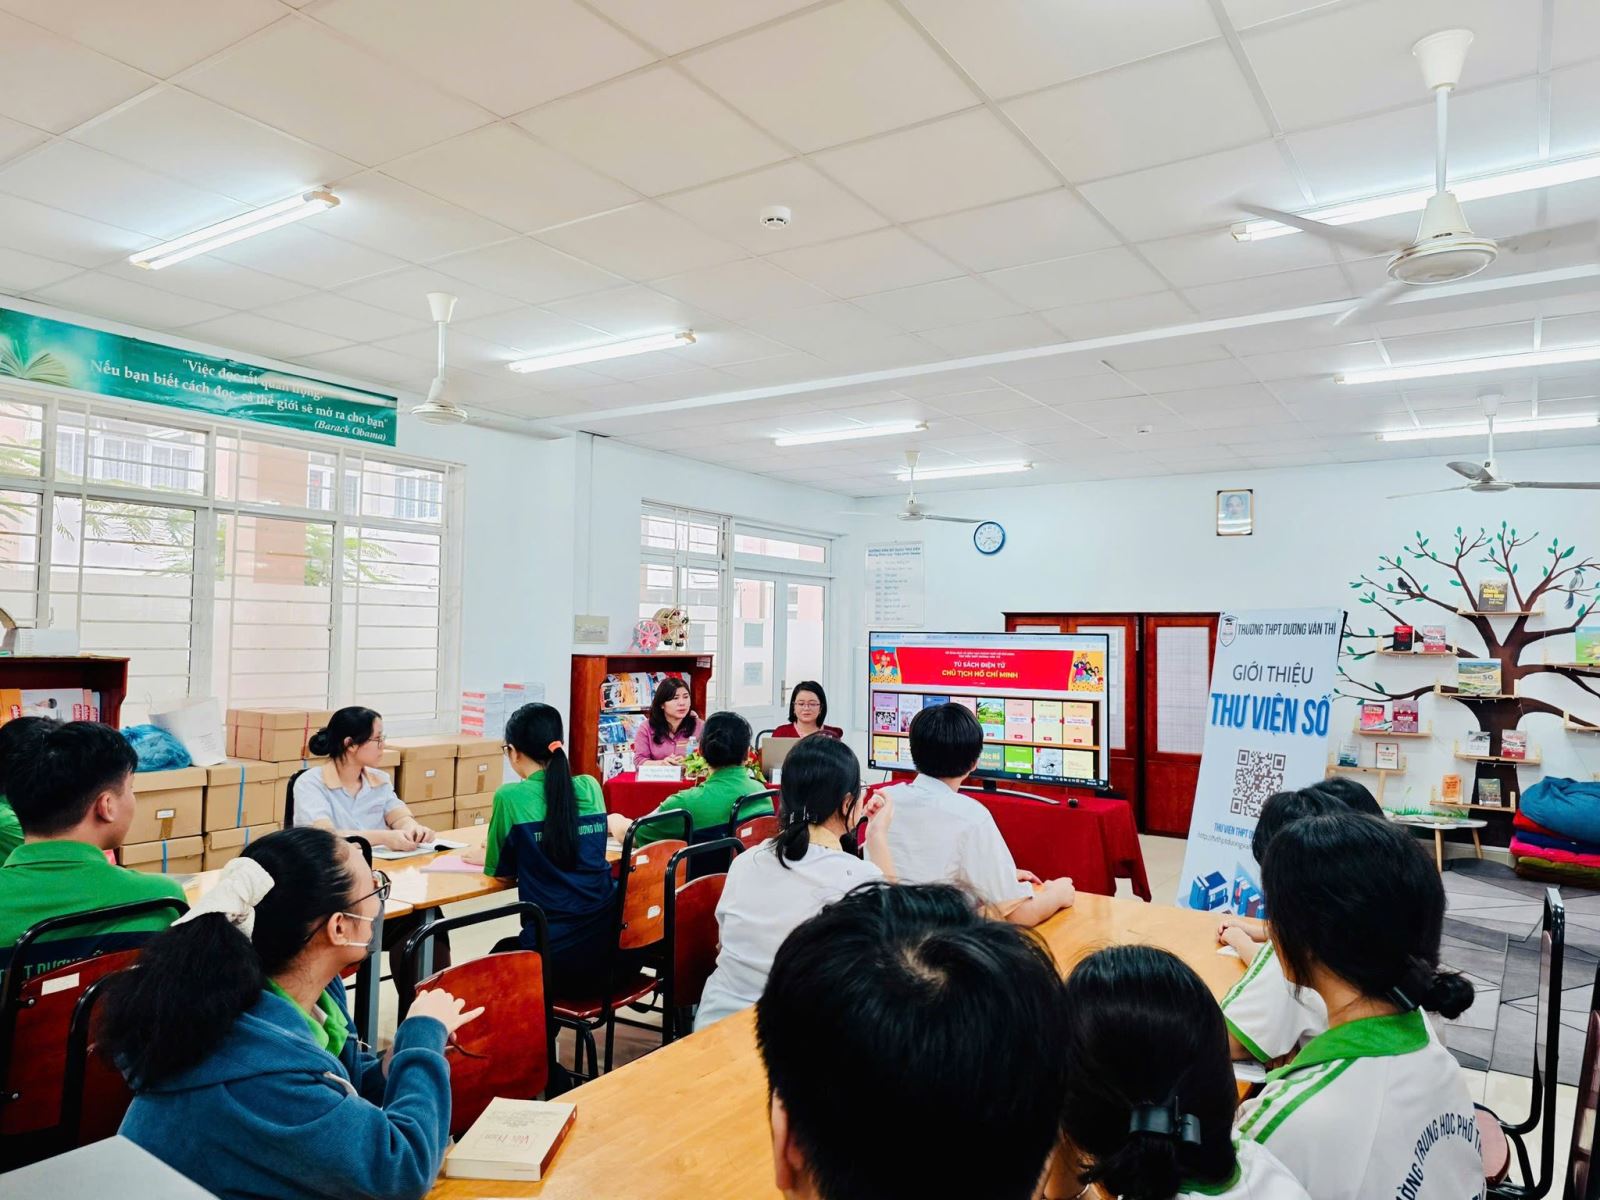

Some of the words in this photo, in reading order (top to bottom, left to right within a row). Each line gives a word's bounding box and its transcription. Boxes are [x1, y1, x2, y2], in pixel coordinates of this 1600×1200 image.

[91, 360, 120, 376] Nếu
[124, 366, 149, 383] bạn
[154, 372, 180, 388] biết
[182, 379, 209, 394] cách
[277, 399, 299, 412] giới
[301, 404, 313, 414] sẽ
[316, 405, 333, 417] mở
[335, 411, 345, 420] ra
[347, 412, 365, 424] cho
[314, 420, 350, 434] (Barack
[351, 426, 386, 441] Obama)
[1265, 623, 1282, 635] THPT
[958, 670, 973, 678] TỊCH
[986, 669, 998, 678] CHÍ
[963, 660, 979, 668] SÁCH
[1233, 660, 1263, 681] GIỚI
[1267, 662, 1313, 687] THIỆU
[1211, 693, 1250, 728] THƯ
[1252, 692, 1298, 735] VIỆN
[1301, 693, 1331, 736] SỐ
[1414, 1119, 1439, 1166] TRUNG
[1439, 1112, 1456, 1140] HỌC
[1457, 1113, 1475, 1143] PHỔ
